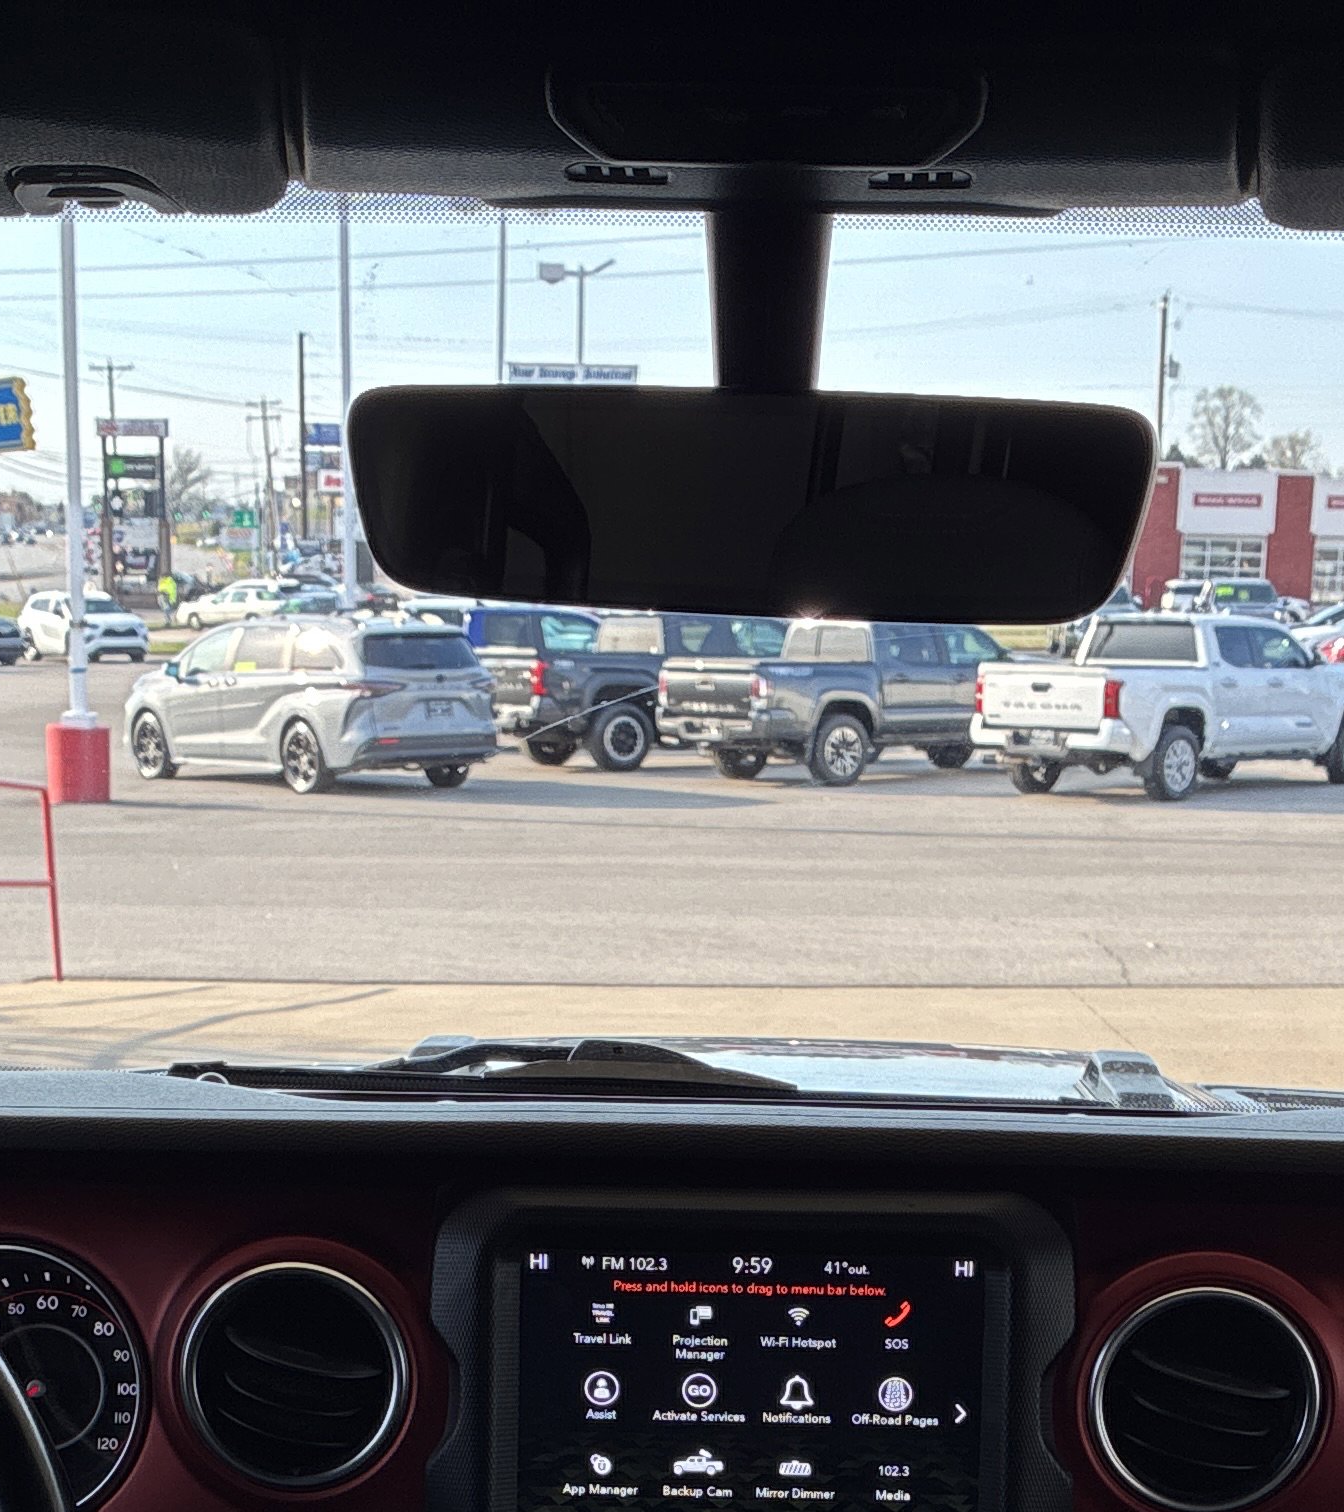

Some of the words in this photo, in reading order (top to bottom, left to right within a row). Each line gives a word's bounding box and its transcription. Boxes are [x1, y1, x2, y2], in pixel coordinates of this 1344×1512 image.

[530, 1254, 548, 1269] HI
[603, 1257, 624, 1270] FM
[629, 1257, 667, 1270] 102.3
[733, 1257, 772, 1274] 9:59
[955, 1261, 974, 1277] HI
[614, 1280, 642, 1292] Press
[646, 1281, 668, 1292] and
[671, 1281, 696, 1292] hold
[698, 1283, 728, 1293] icons
[732, 1284, 743, 1293] to
[747, 1283, 773, 1296] drag
[776, 1284, 788, 1294] to
[791, 1286, 824, 1294] menu
[827, 1284, 847, 1295] bar
[850, 1285, 885, 1296] below.
[8, 1303, 25, 1315] 50
[36, 1296, 59, 1310] 60
[71, 1305, 87, 1318] 70
[93, 1321, 115, 1336] 80
[573, 1333, 606, 1344] Travel
[609, 1334, 631, 1344] Link
[673, 1335, 728, 1350] Projection
[760, 1336, 788, 1347] Wi-Fi
[792, 1337, 836, 1350] Hotspot
[885, 1338, 908, 1349] SOS
[113, 1350, 130, 1362] 90
[676, 1348, 725, 1361] Manager
[117, 1383, 138, 1395] 100
[687, 1383, 711, 1397] GO
[114, 1412, 130, 1424] 110
[586, 1409, 616, 1419] Assist
[653, 1410, 697, 1421] Activate
[701, 1411, 745, 1422] Services
[763, 1412, 831, 1424] Notifications
[852, 1413, 900, 1425] Off-Road
[905, 1415, 938, 1428] Pages
[97, 1438, 118, 1450] 120
[879, 1465, 909, 1476] 102.3
[562, 1483, 585, 1496] App
[589, 1484, 638, 1497] Manager
[663, 1485, 701, 1498] Backup
[707, 1486, 732, 1497] Cam
[756, 1487, 789, 1498] Mirror
[792, 1488, 835, 1499] Dimmer
[876, 1490, 910, 1501] Media
